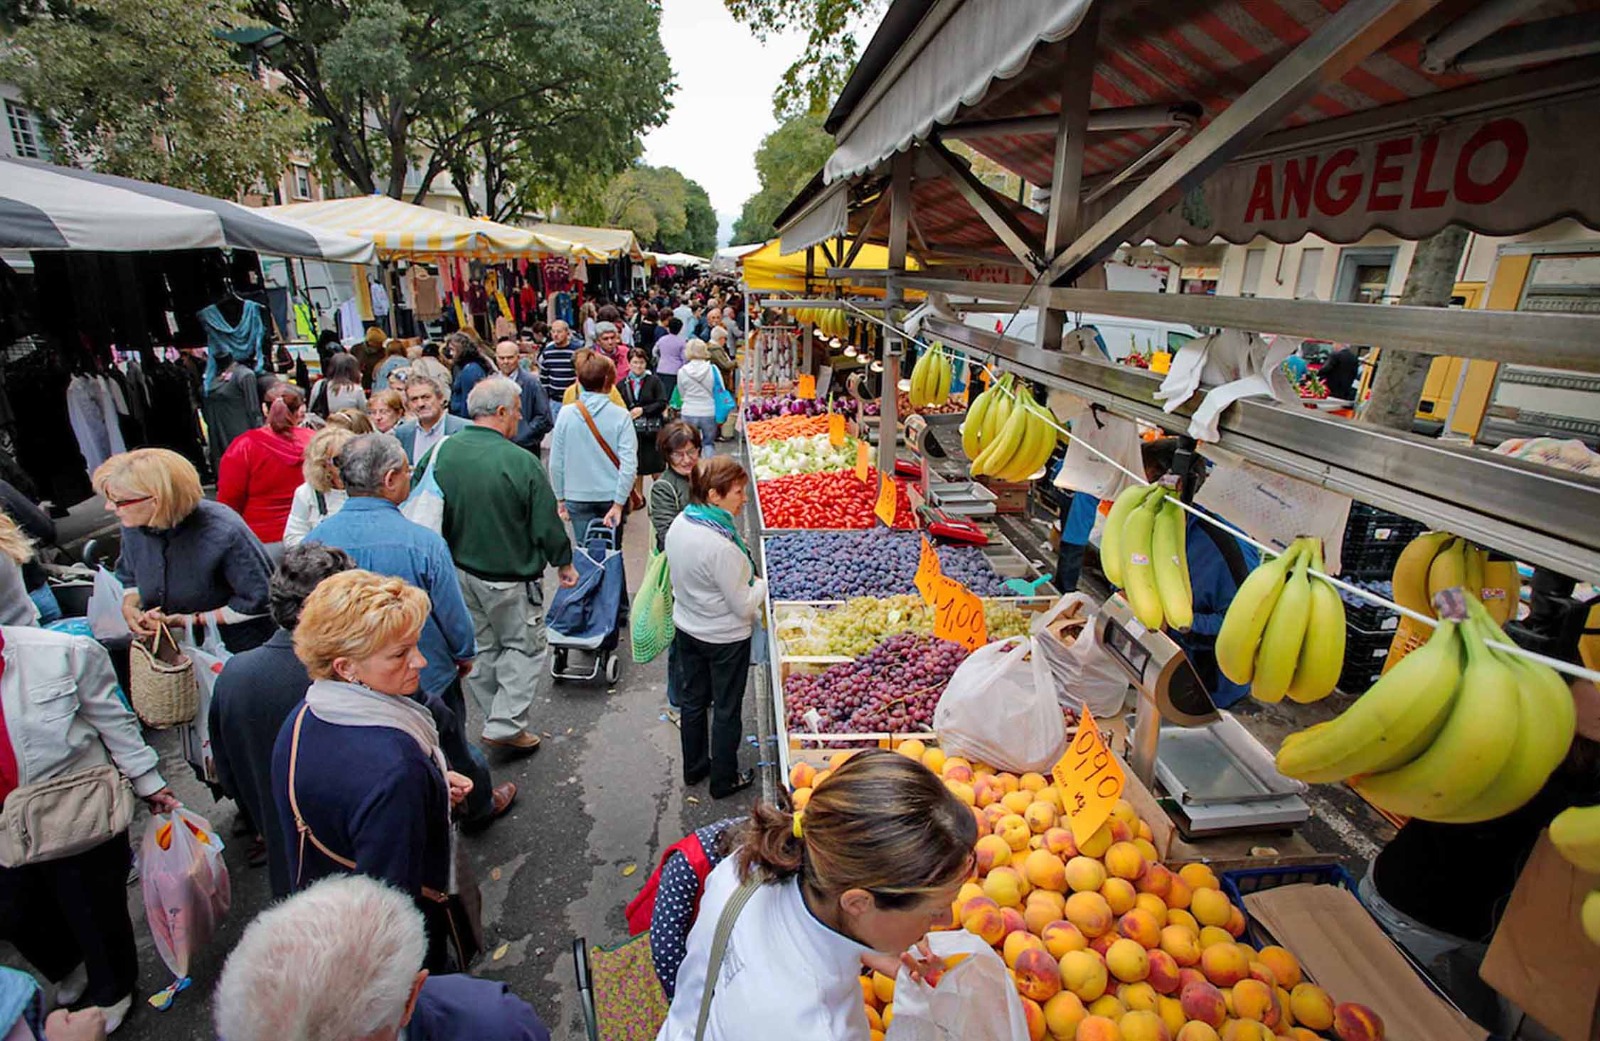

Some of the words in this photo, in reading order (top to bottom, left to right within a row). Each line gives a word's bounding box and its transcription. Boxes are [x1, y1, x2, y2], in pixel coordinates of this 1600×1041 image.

[1244, 118, 1529, 223] ANGELO
[941, 597, 983, 633] 1,00
[1074, 730, 1120, 798] 0,90
